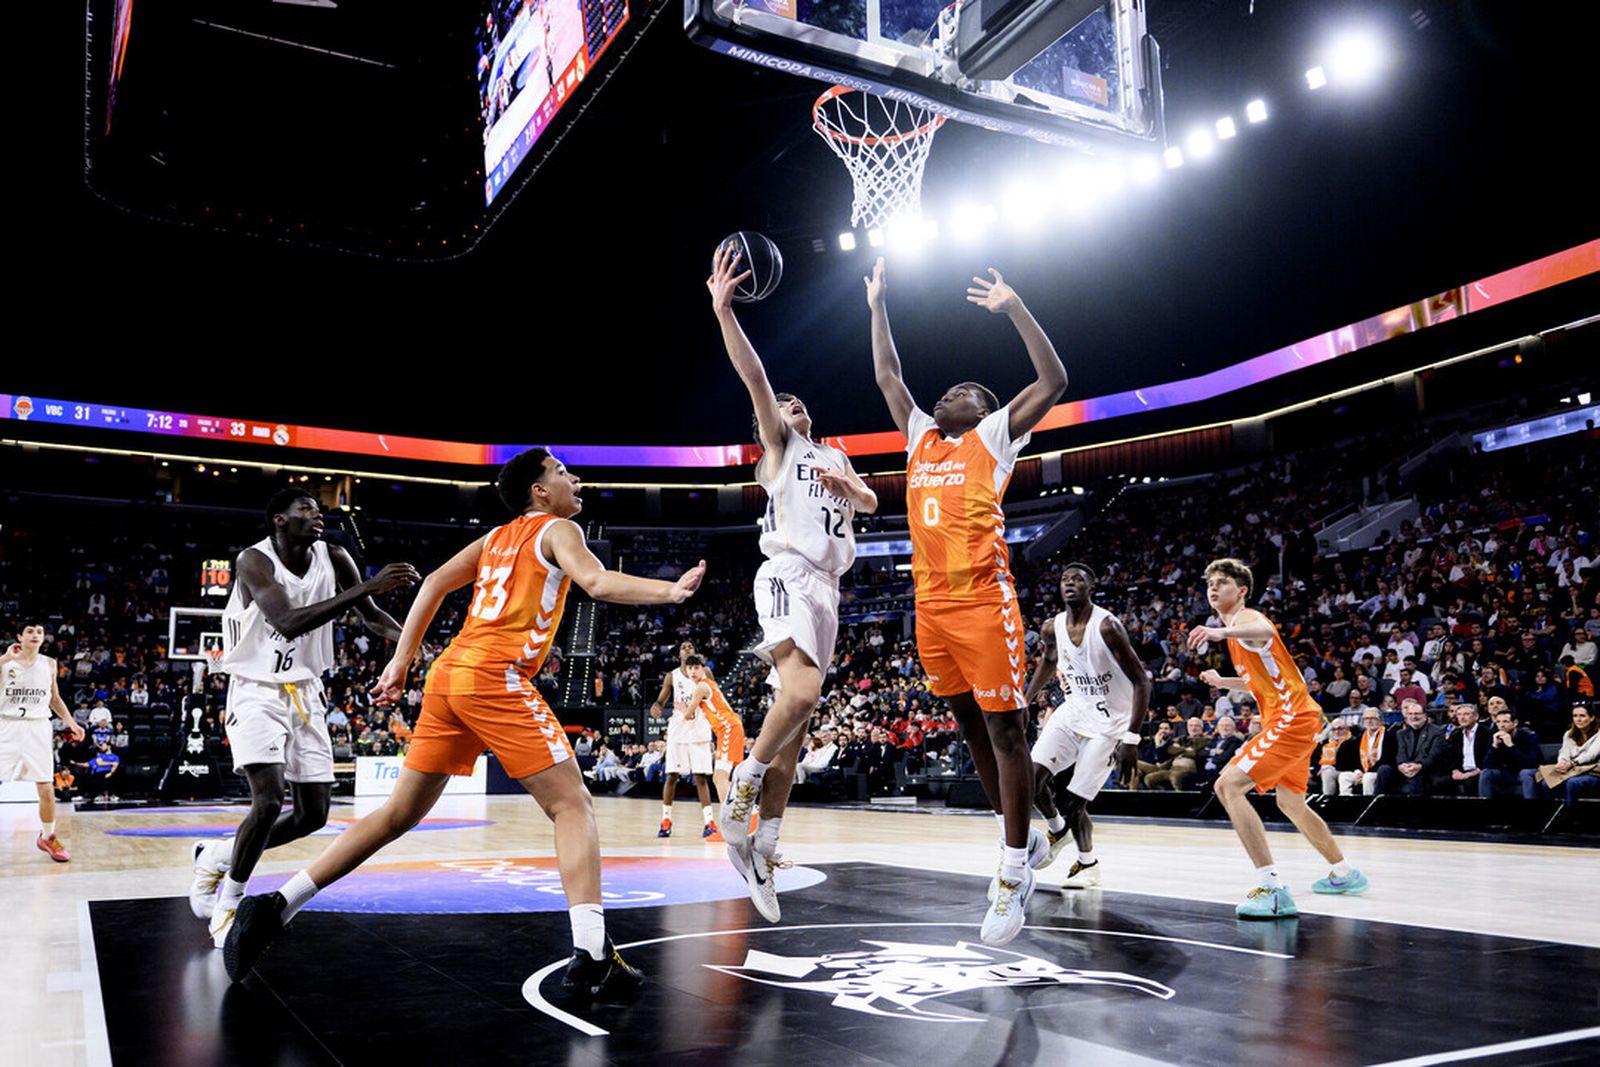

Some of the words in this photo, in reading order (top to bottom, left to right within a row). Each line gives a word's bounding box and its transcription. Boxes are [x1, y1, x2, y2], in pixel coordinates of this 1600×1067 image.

[728, 46, 811, 77] MINICOPA
[814, 70, 872, 91] endesa
[885, 89, 960, 118] MINICOPA
[45, 404, 64, 416] VBC
[74, 406, 90, 420] 31
[146, 413, 173, 429] 7:12
[230, 422, 246, 436] 33
[821, 506, 846, 538] 12
[923, 496, 939, 527] 0
[207, 570, 230, 586] 10
[470, 565, 513, 620] 13
[274, 647, 296, 674] 16
[5, 687, 47, 696] Emirates
